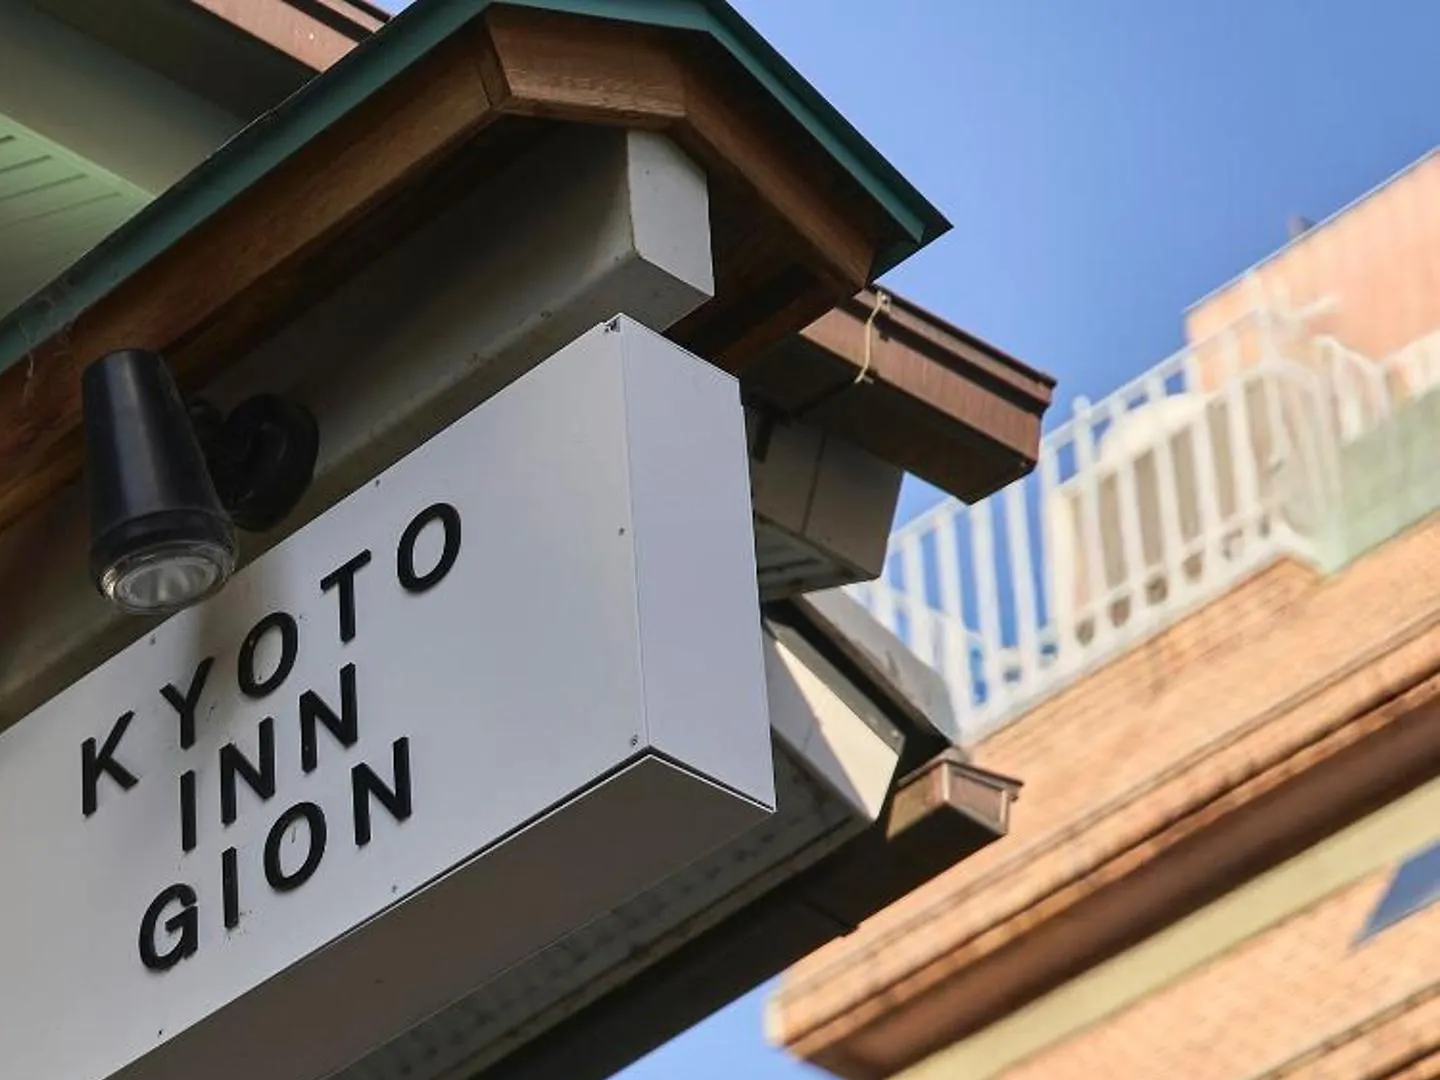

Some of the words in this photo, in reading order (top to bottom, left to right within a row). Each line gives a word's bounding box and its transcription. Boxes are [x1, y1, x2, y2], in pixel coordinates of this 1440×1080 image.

[81, 502, 461, 817] KYOTO
[179, 662, 359, 852] INN
[138, 736, 413, 971] GION
